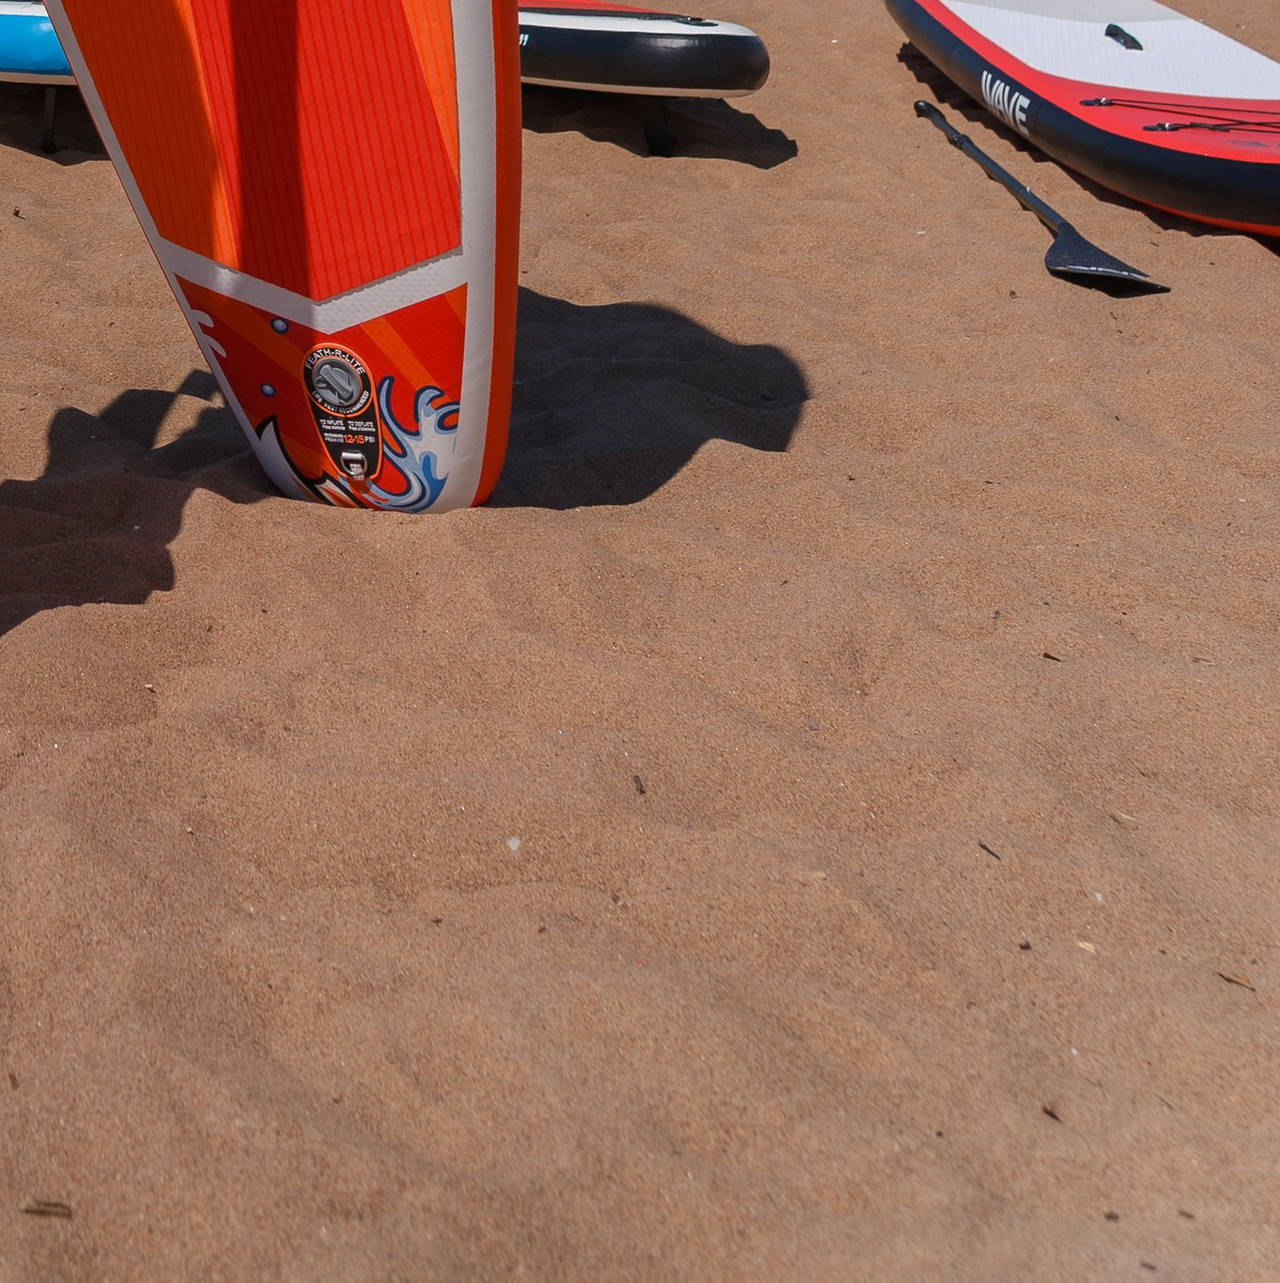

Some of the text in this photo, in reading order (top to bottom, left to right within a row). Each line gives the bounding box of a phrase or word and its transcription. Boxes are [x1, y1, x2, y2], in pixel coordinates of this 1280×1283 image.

[981, 70, 1031, 136] WAVE
[305, 348, 366, 376] FEATH-R-LITE
[343, 434, 365, 444] 12-15
